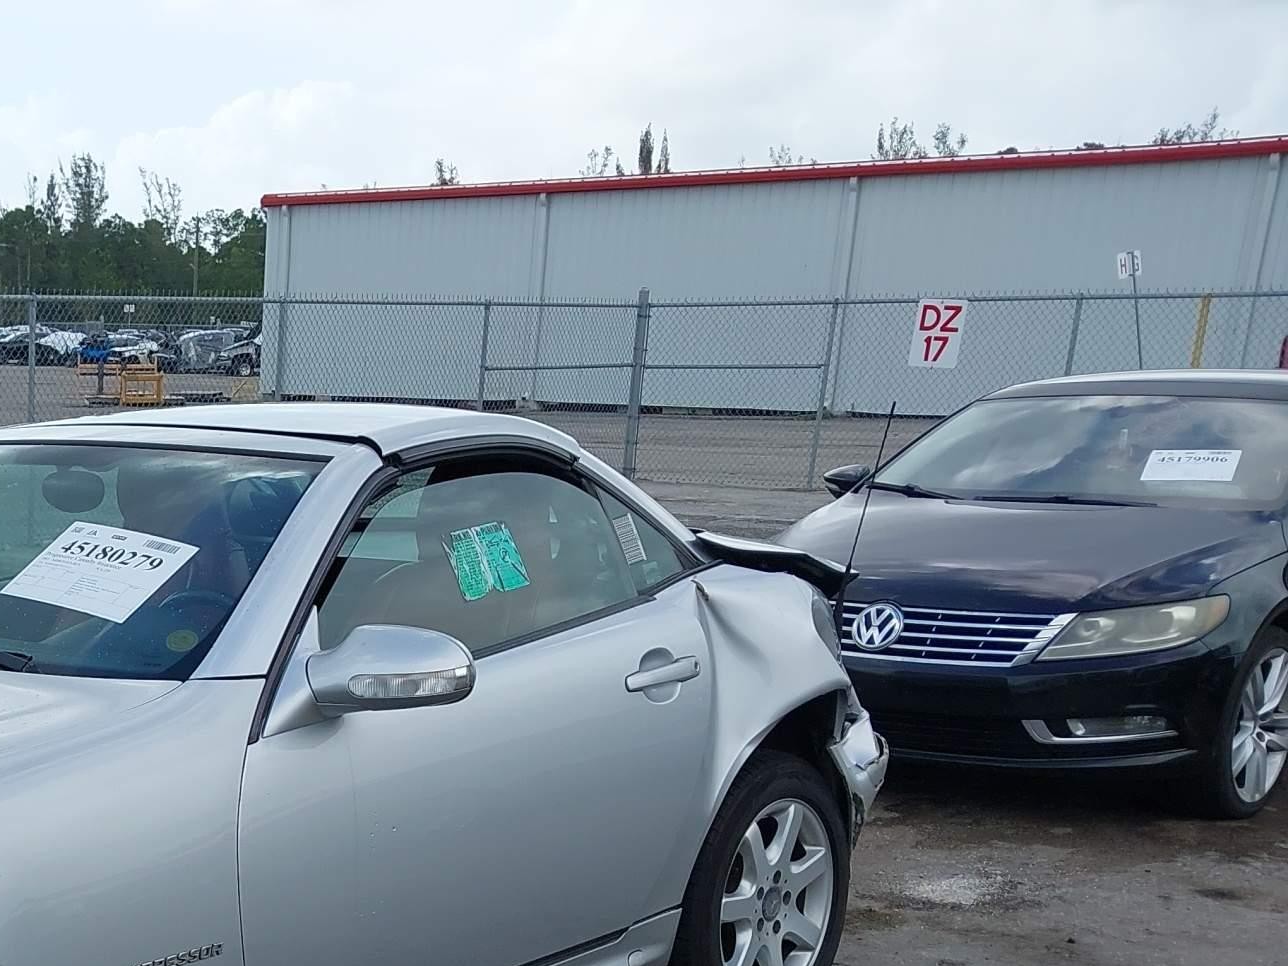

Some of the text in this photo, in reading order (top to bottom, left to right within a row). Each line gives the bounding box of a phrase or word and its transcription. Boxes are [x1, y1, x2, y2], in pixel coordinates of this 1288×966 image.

[919, 304, 963, 333] DZ
[923, 335, 950, 362] 17
[61, 540, 165, 572] 45180279
[856, 604, 901, 648] VW
